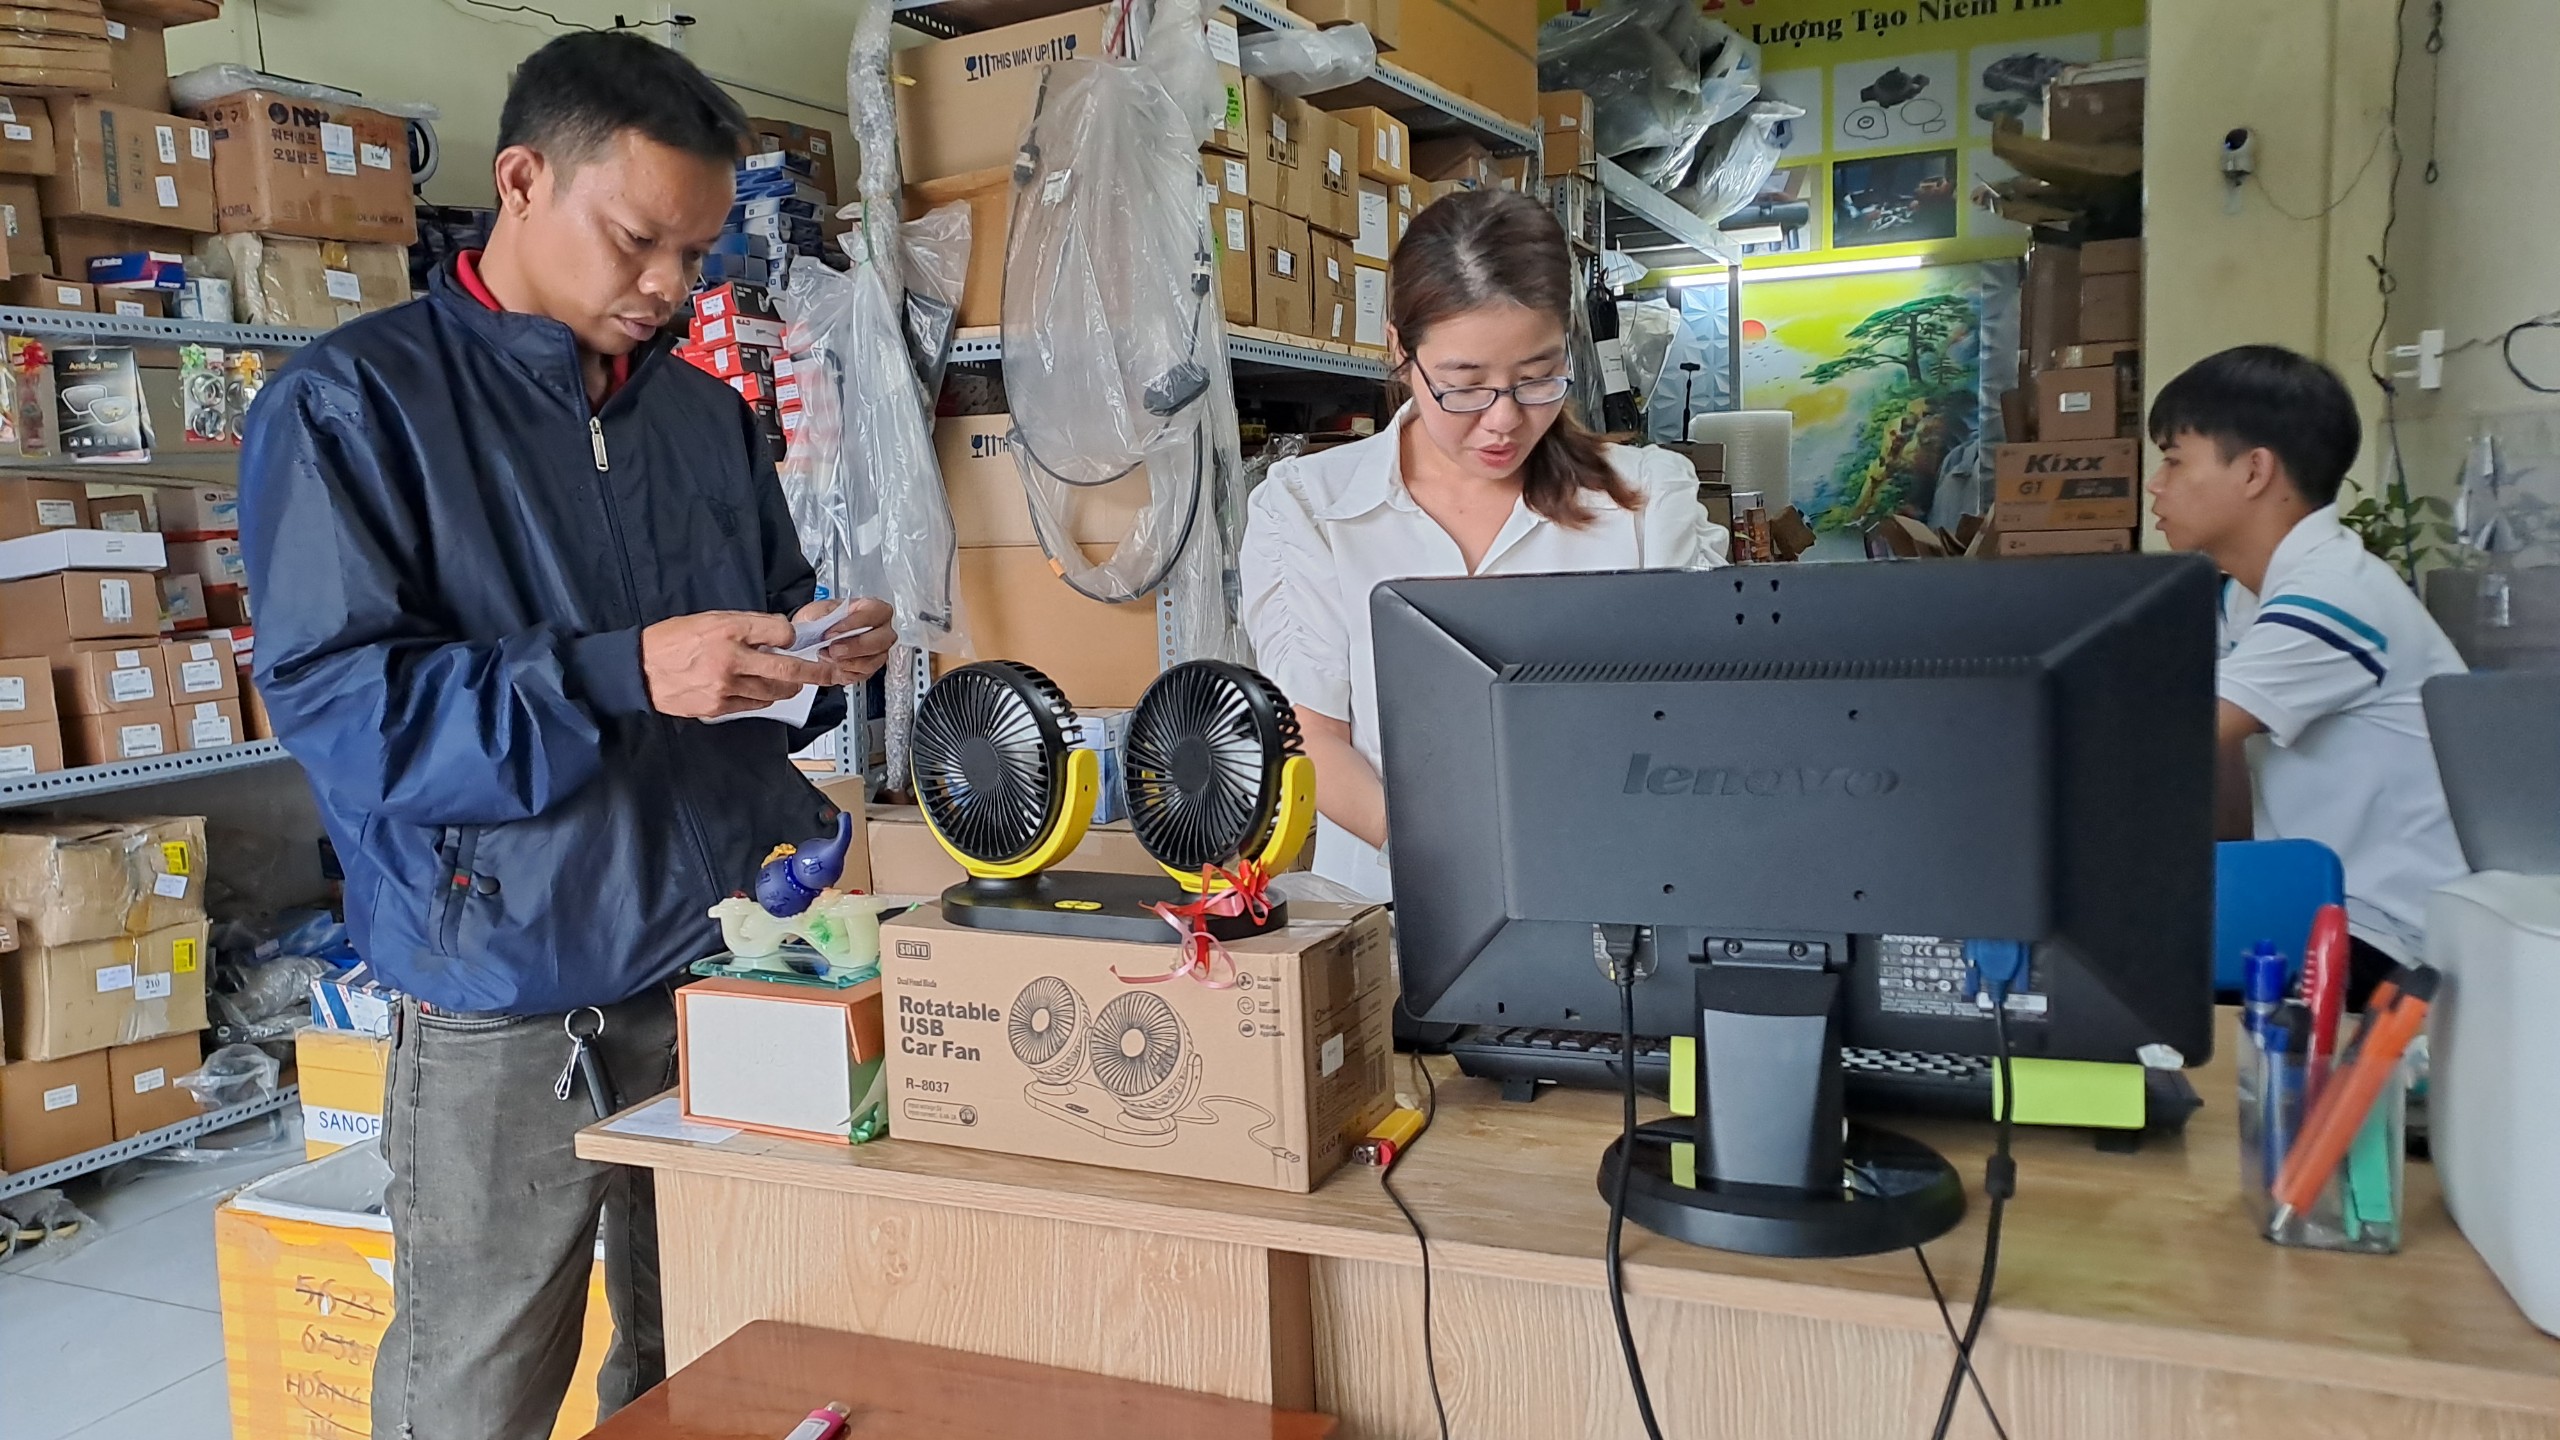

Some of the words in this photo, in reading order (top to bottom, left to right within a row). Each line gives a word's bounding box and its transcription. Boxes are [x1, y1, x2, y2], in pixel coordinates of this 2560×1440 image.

[1852, 8, 1908, 37] Tạo
[990, 52, 1012, 72] THIS
[1012, 46, 1033, 67] WAY
[221, 203, 252, 218] KOREA
[104, 361, 118, 369] film
[2024, 453, 2106, 474] Kixx
[1622, 753, 1899, 797] lenovo
[145, 978, 160, 990] 210
[899, 995, 1001, 1022] Rotatable
[900, 1015, 944, 1037] USB
[901, 1036, 938, 1057] Car
[942, 1040, 981, 1061] Fan
[905, 1077, 950, 1094] R-8037
